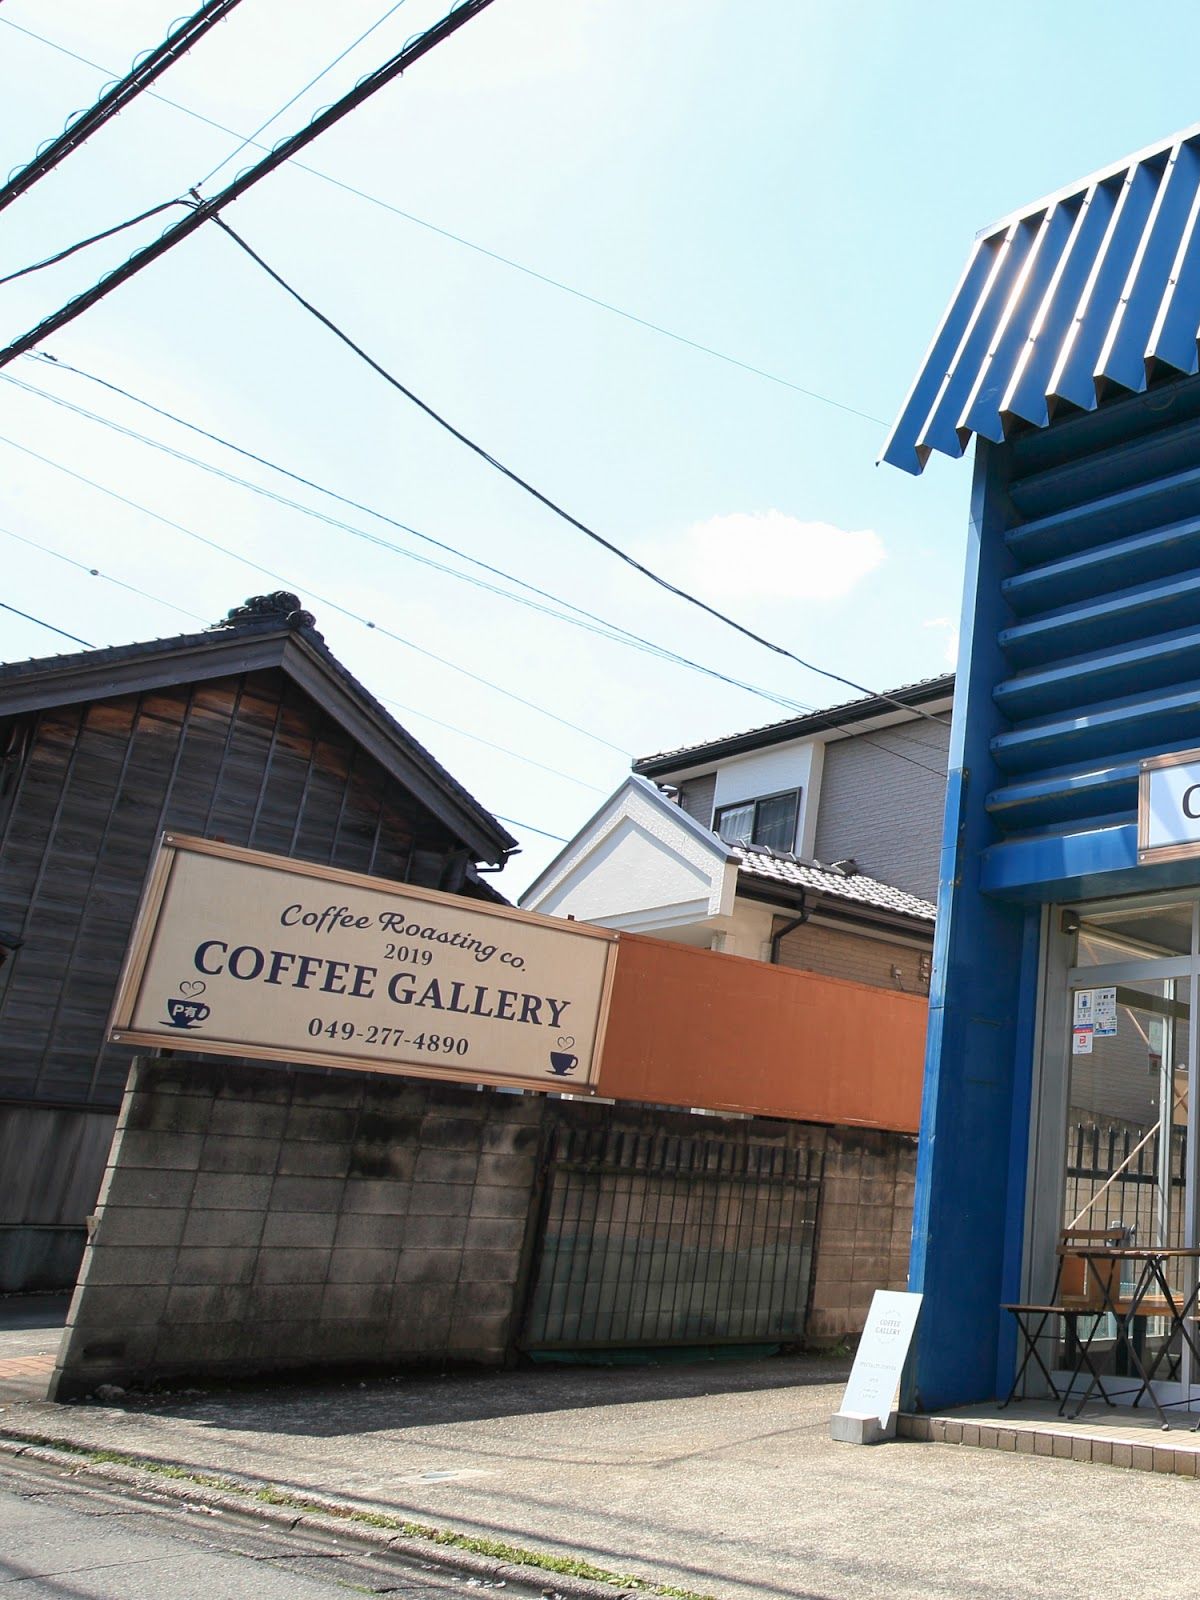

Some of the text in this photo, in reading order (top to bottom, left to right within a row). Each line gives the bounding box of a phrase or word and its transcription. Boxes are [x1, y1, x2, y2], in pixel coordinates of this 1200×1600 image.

[280, 904, 526, 973] Coffee Roasting co.
[383, 943, 433, 967] 2019
[193, 940, 571, 1029] COFFEE GALLERY
[308, 1017, 470, 1056] 049-277-4890
